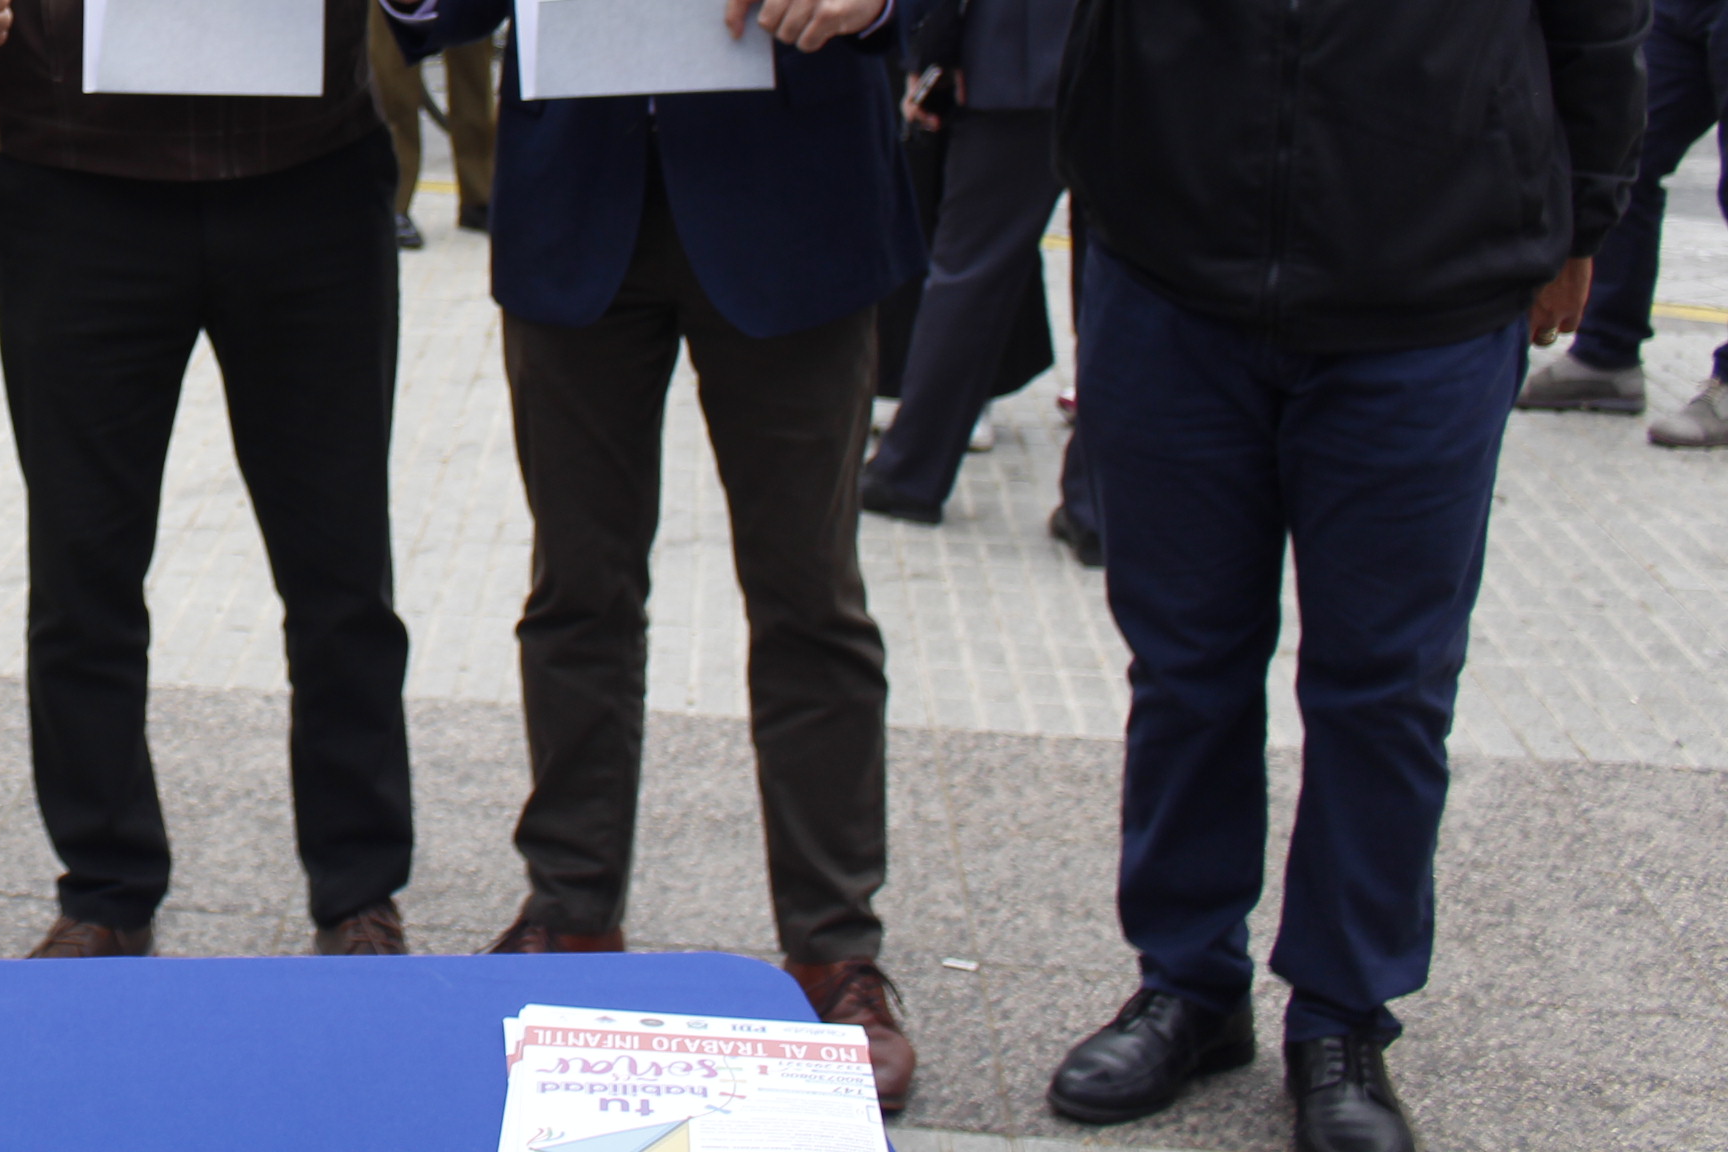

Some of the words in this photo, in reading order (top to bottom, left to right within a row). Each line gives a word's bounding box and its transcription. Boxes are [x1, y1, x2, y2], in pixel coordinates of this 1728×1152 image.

[536, 1028, 640, 1049] INFANTIL
[651, 1036, 769, 1056] TRABAJO
[779, 1043, 808, 1058] AL
[820, 1046, 858, 1061] NO
[536, 1054, 719, 1081] soñar
[540, 1082, 708, 1098] habilidad
[599, 1097, 654, 1116] tu
